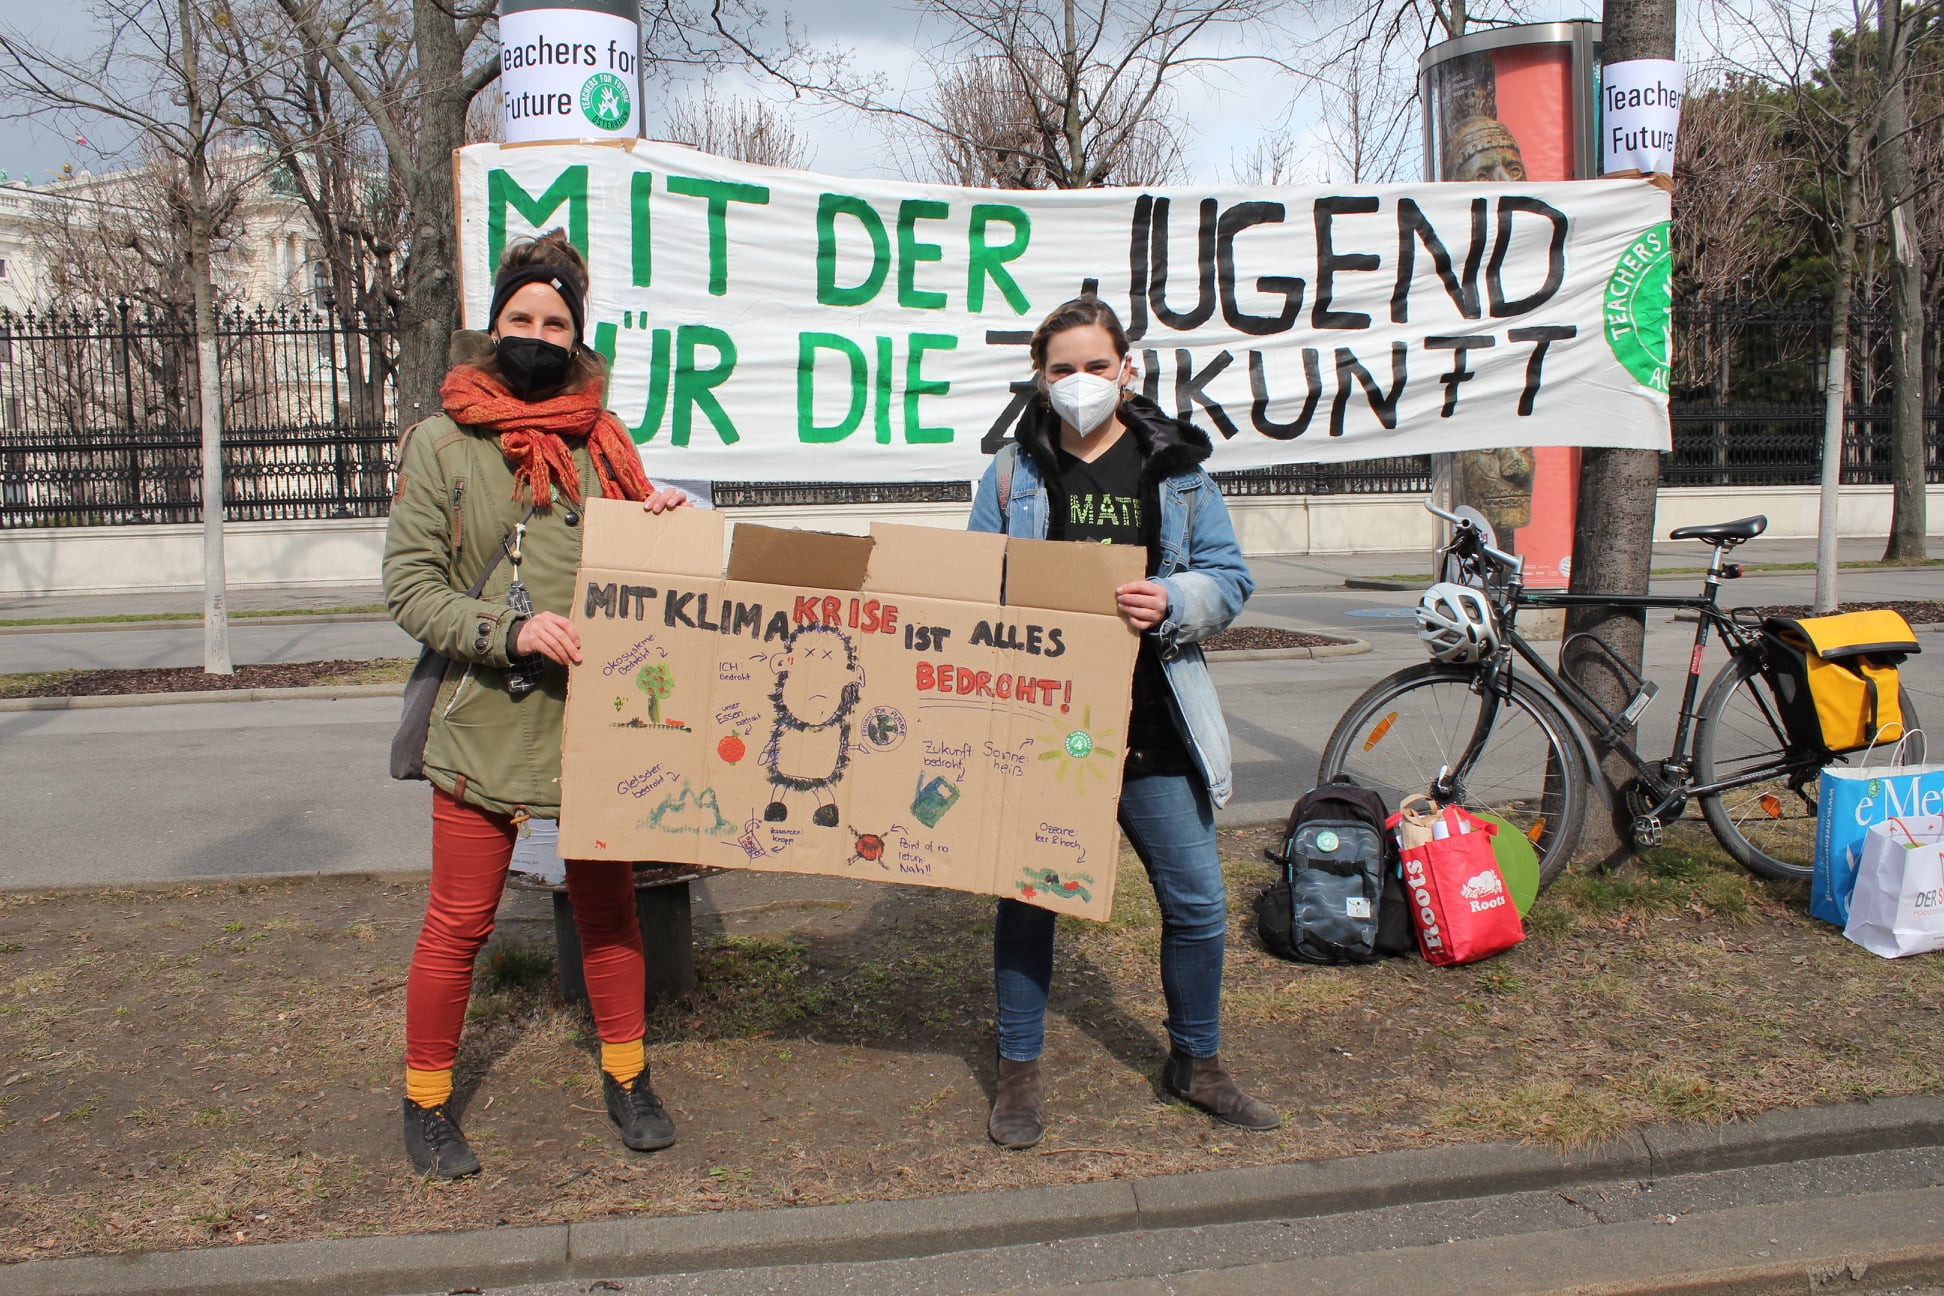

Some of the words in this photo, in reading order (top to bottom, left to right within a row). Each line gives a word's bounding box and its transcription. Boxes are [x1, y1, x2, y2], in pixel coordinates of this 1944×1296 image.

[607, 39, 635, 75] for
[504, 91, 572, 122] Future
[600, 74, 612, 84] FOR
[613, 78, 630, 104] FUTURE
[1606, 80, 1683, 111] Teacher
[1613, 126, 1673, 154] Future
[487, 164, 771, 296] MIT
[817, 193, 1031, 317] DER
[1081, 194, 1569, 342] JUGEND
[1606, 233, 1662, 341] TEACHERS
[594, 309, 740, 447] ÜR
[798, 330, 958, 445] DIE
[584, 582, 658, 621] MIT
[905, 623, 951, 652] IST
[968, 620, 1066, 658] ALLES
[916, 661, 1072, 714] BEDROHT!
[1406, 859, 1445, 955] Roots
[1469, 895, 1506, 913] Roots
[1914, 889, 1938, 908] DER
